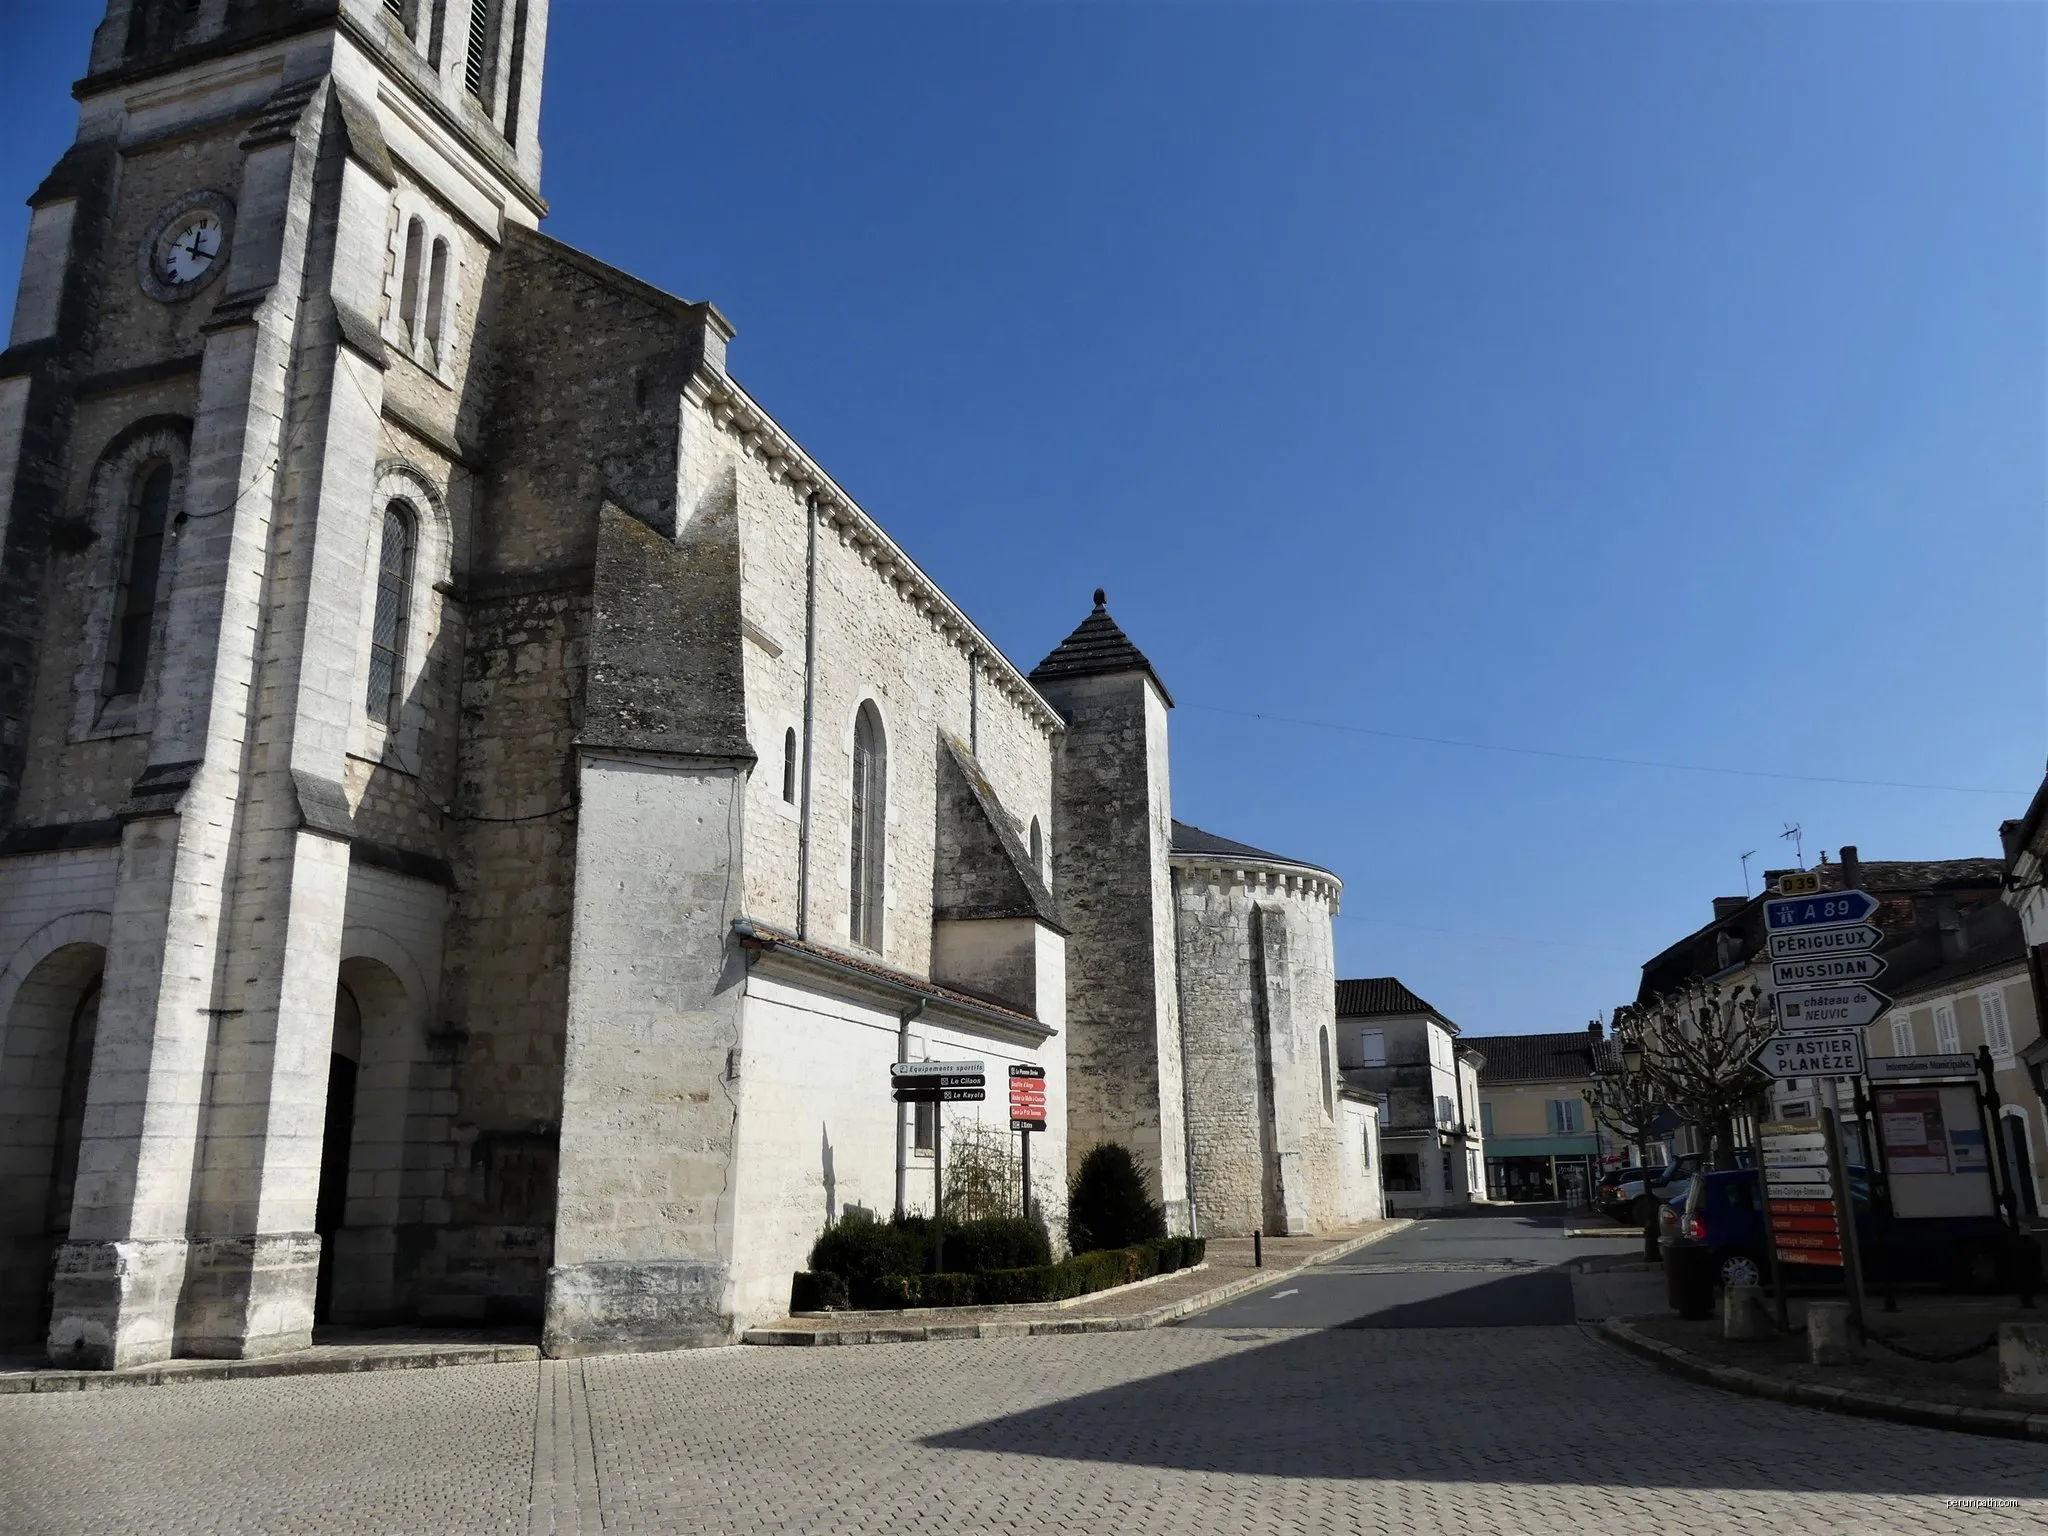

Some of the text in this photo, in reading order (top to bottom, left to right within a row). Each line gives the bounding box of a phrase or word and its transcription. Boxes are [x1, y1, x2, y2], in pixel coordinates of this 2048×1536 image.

[1783, 877, 1816, 891] D 39
[1804, 900, 1850, 920] A 89
[1777, 931, 1867, 952] PÉRIGUEUX
[1780, 960, 1867, 980] MUSSIDAN
[1804, 993, 1868, 1007] château de
[1805, 1008, 1849, 1021] NEUVIC
[1796, 1039, 1852, 1055] ASTIER
[909, 1063, 983, 1073] Equipements sportifs
[1779, 1054, 1855, 1072] PLANÈZE
[1929, 1058, 1971, 1071] Municipales
[950, 1077, 959, 1085] Le
